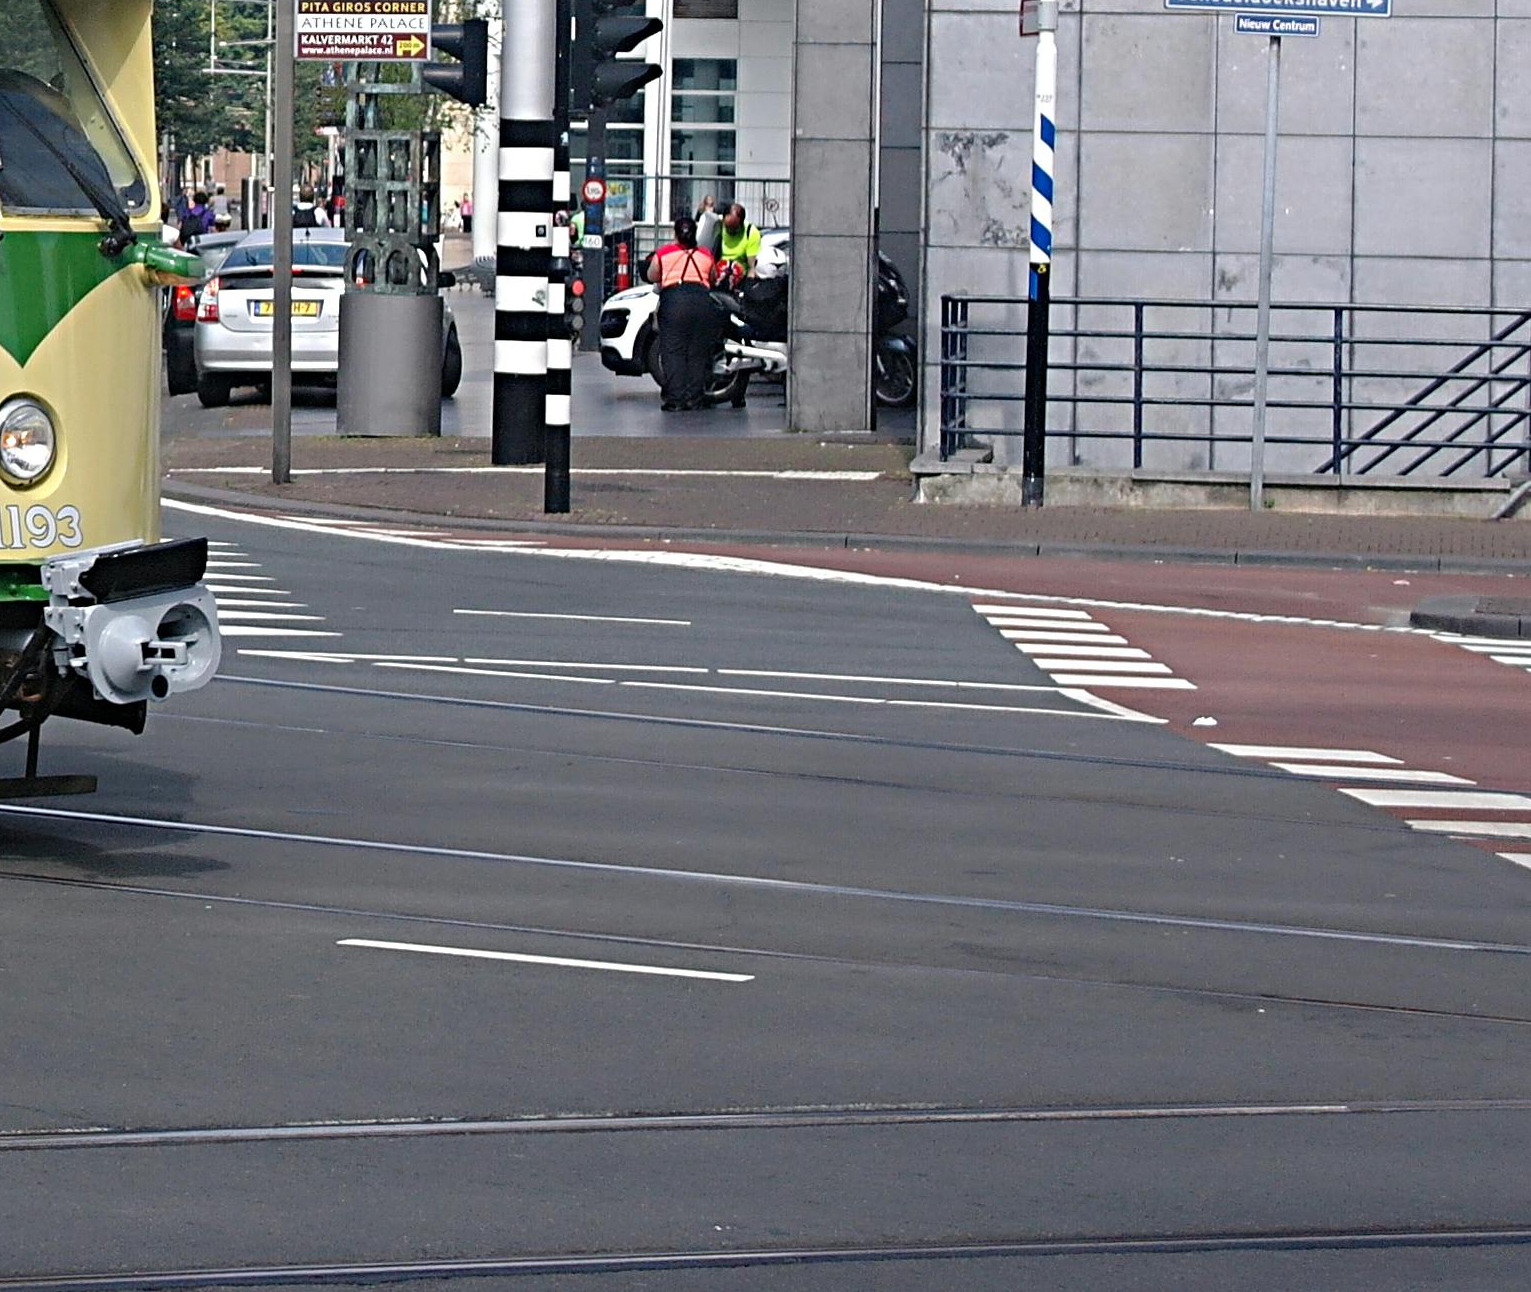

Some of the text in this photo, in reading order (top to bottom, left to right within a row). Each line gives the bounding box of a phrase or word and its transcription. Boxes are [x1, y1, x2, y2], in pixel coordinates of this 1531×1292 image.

[301, 2, 426, 13] PITA GIROS CORNER
[301, 17, 425, 29] ATHENE PALACE
[1239, 18, 1315, 32] Nieuw Centrum
[301, 34, 394, 45] KALVERMARKT 42
[301, 45, 394, 57] www.athenepalace.nl
